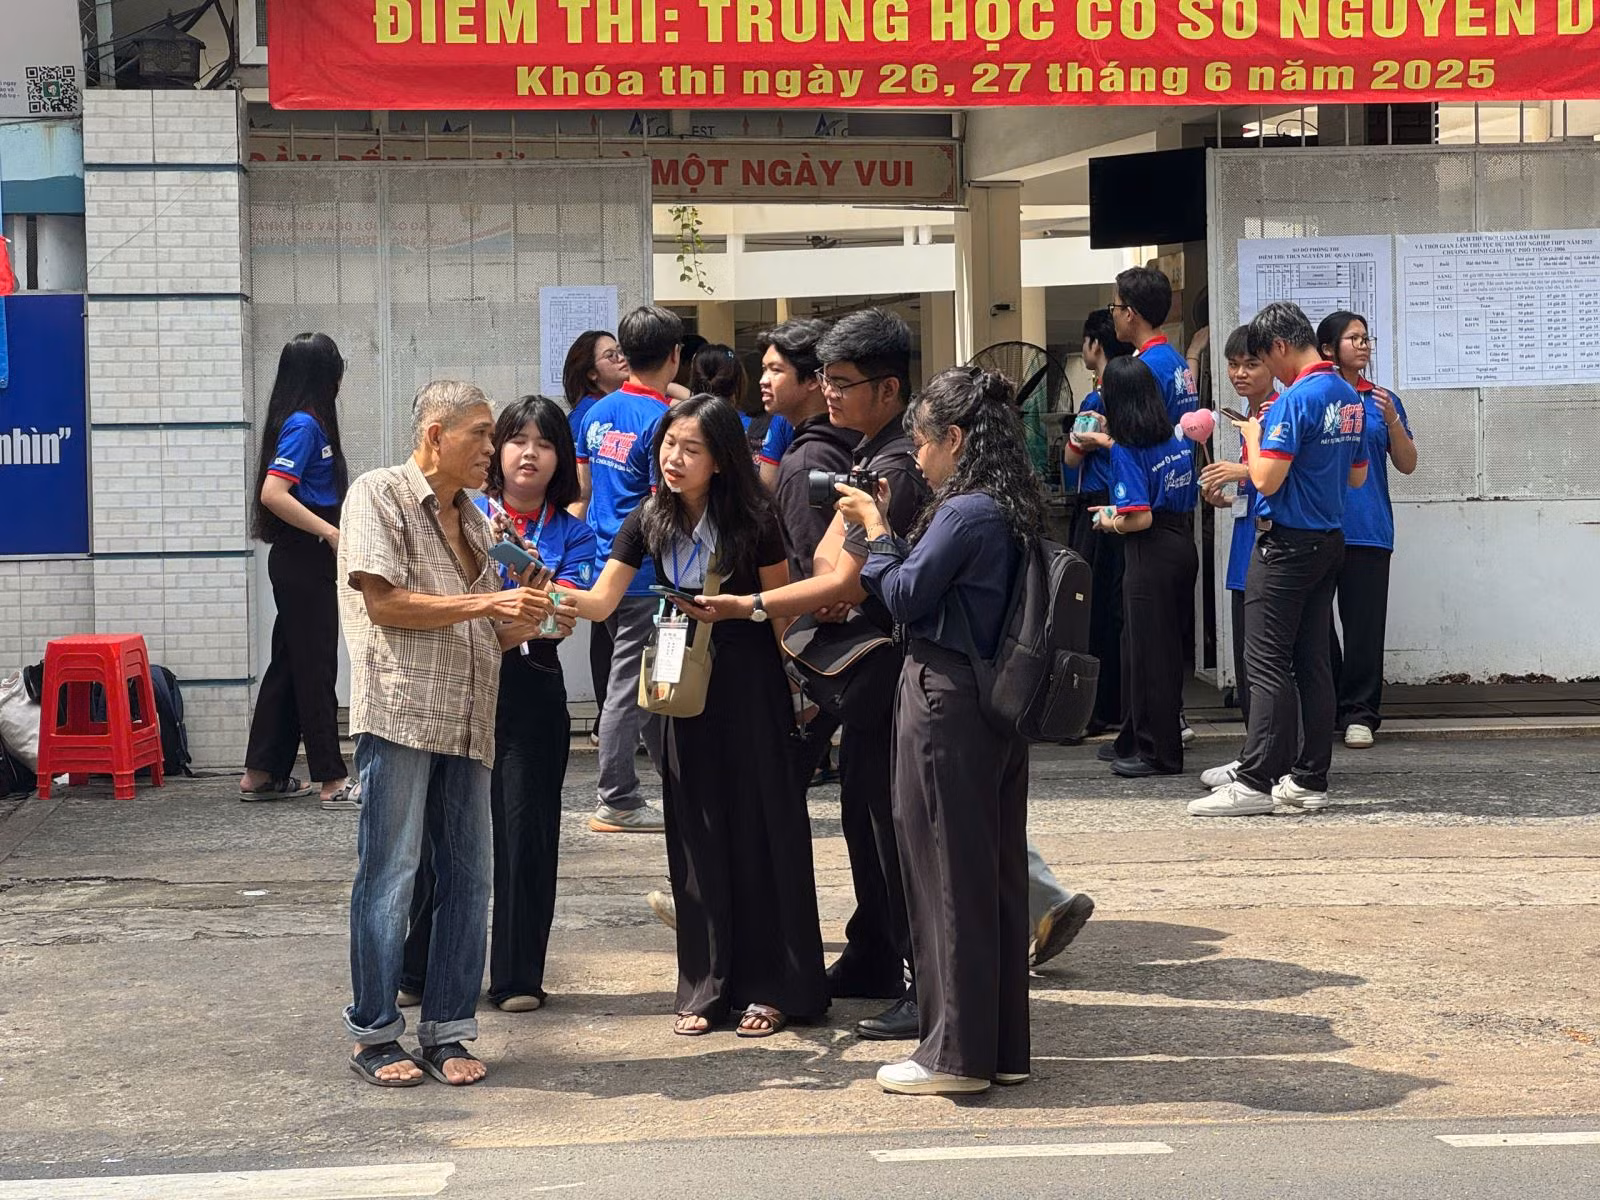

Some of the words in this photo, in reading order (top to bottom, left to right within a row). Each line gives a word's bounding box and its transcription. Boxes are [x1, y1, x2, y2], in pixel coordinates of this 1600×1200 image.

[558, 0, 679, 43] THI:
[699, 0, 909, 42] TRUNG
[930, 0, 1055, 51] HỌC
[516, 65, 644, 96] Khóa
[659, 65, 725, 95] thi
[743, 64, 864, 98] ngày
[878, 63, 956, 97] 26,
[971, 63, 1032, 93] 27
[1046, 61, 1189, 95] tháng
[1204, 61, 1232, 91] 6
[1248, 59, 1354, 91] năm
[1370, 59, 1495, 90] 2025
[652, 152, 729, 193] MỘT
[742, 152, 842, 186] NGÀY
[855, 159, 913, 186] VUI
